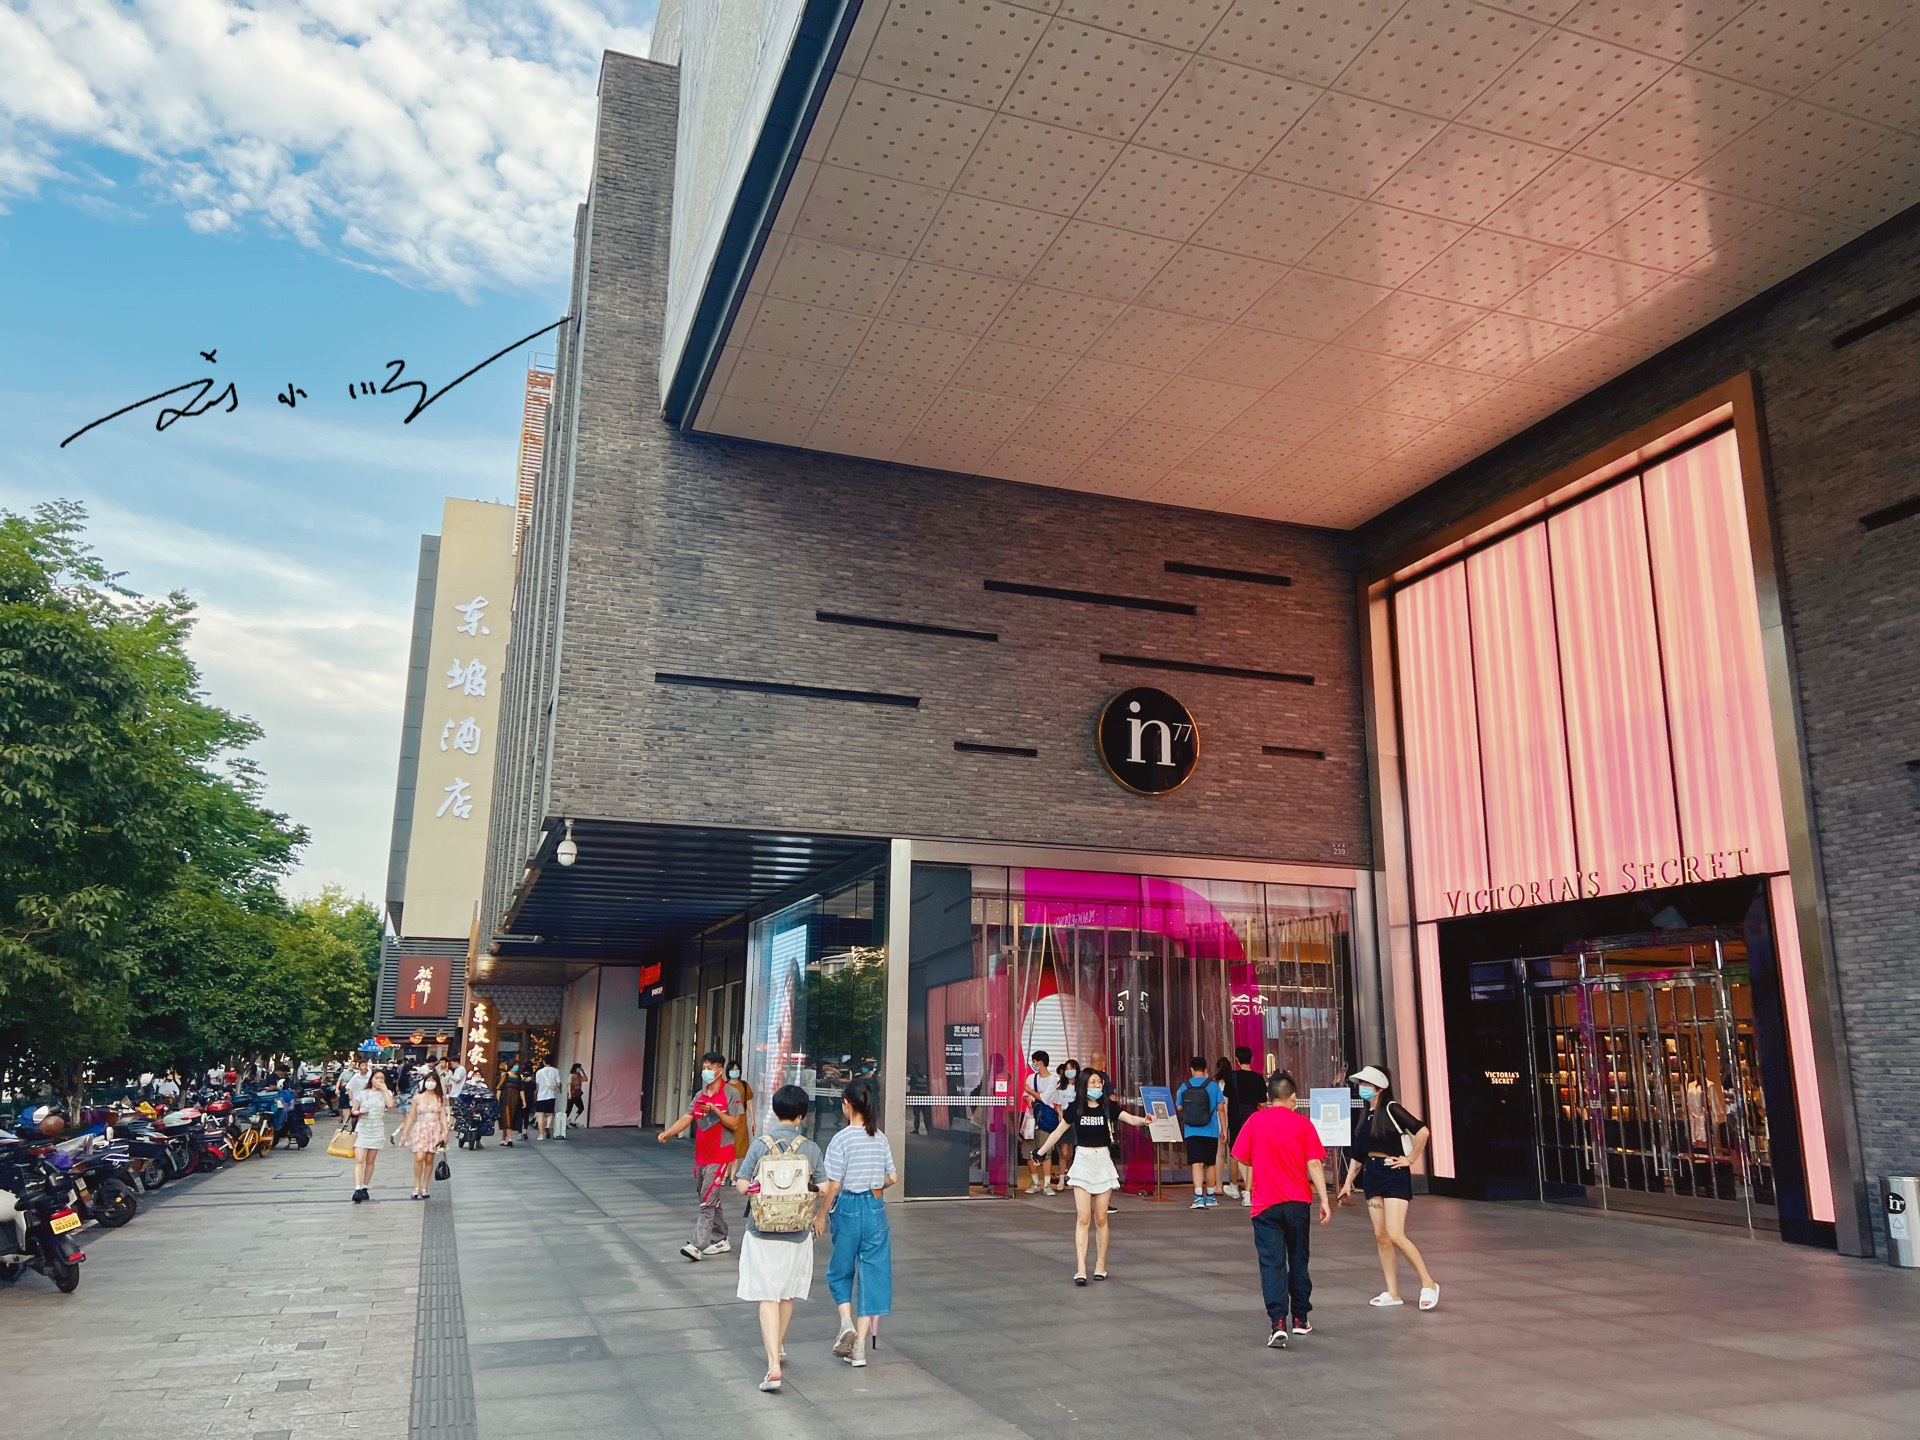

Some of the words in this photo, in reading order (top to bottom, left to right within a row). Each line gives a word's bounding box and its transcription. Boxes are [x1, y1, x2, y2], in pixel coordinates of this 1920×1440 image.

[437, 595, 490, 820] 东坡酒店
[1126, 701, 1193, 766] in77
[1443, 871, 1601, 916] VICTORIA'S
[1621, 847, 1749, 893] SECRET
[954, 1025, 980, 1033] 营业时间
